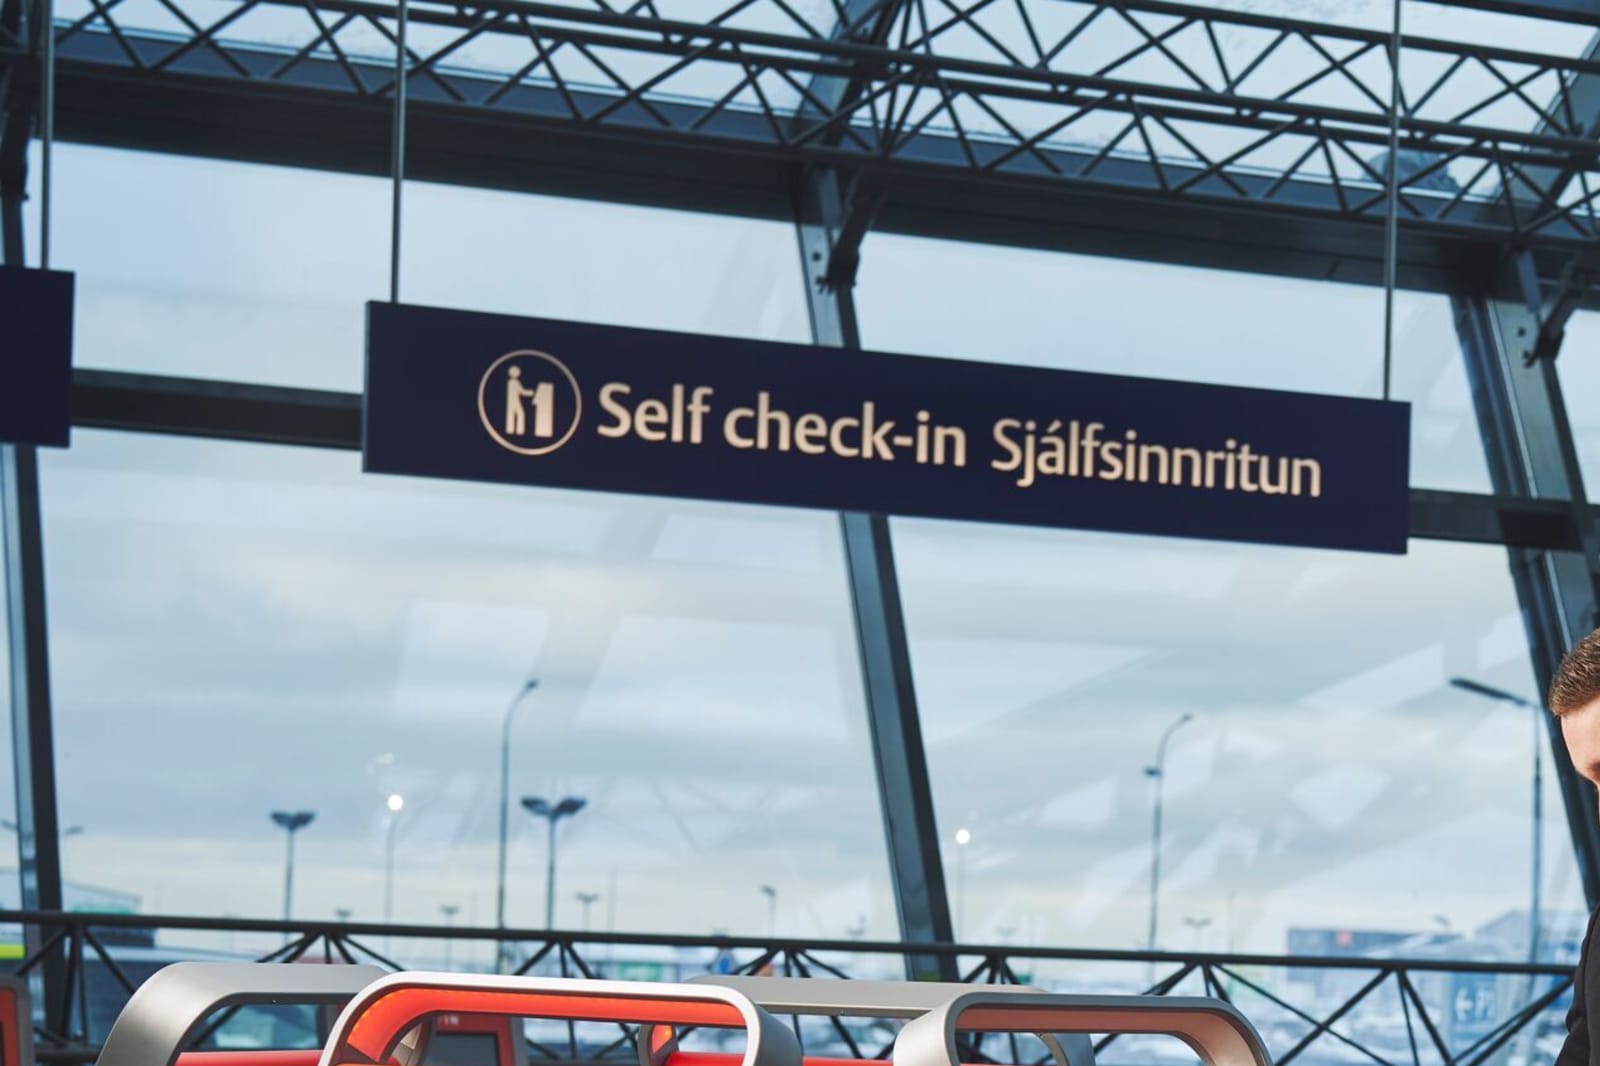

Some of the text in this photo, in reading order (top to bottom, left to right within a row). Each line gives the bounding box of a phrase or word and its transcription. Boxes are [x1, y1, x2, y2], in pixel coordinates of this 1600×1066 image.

[598, 383, 1321, 499] Self check-in Sjálfsinnritun
